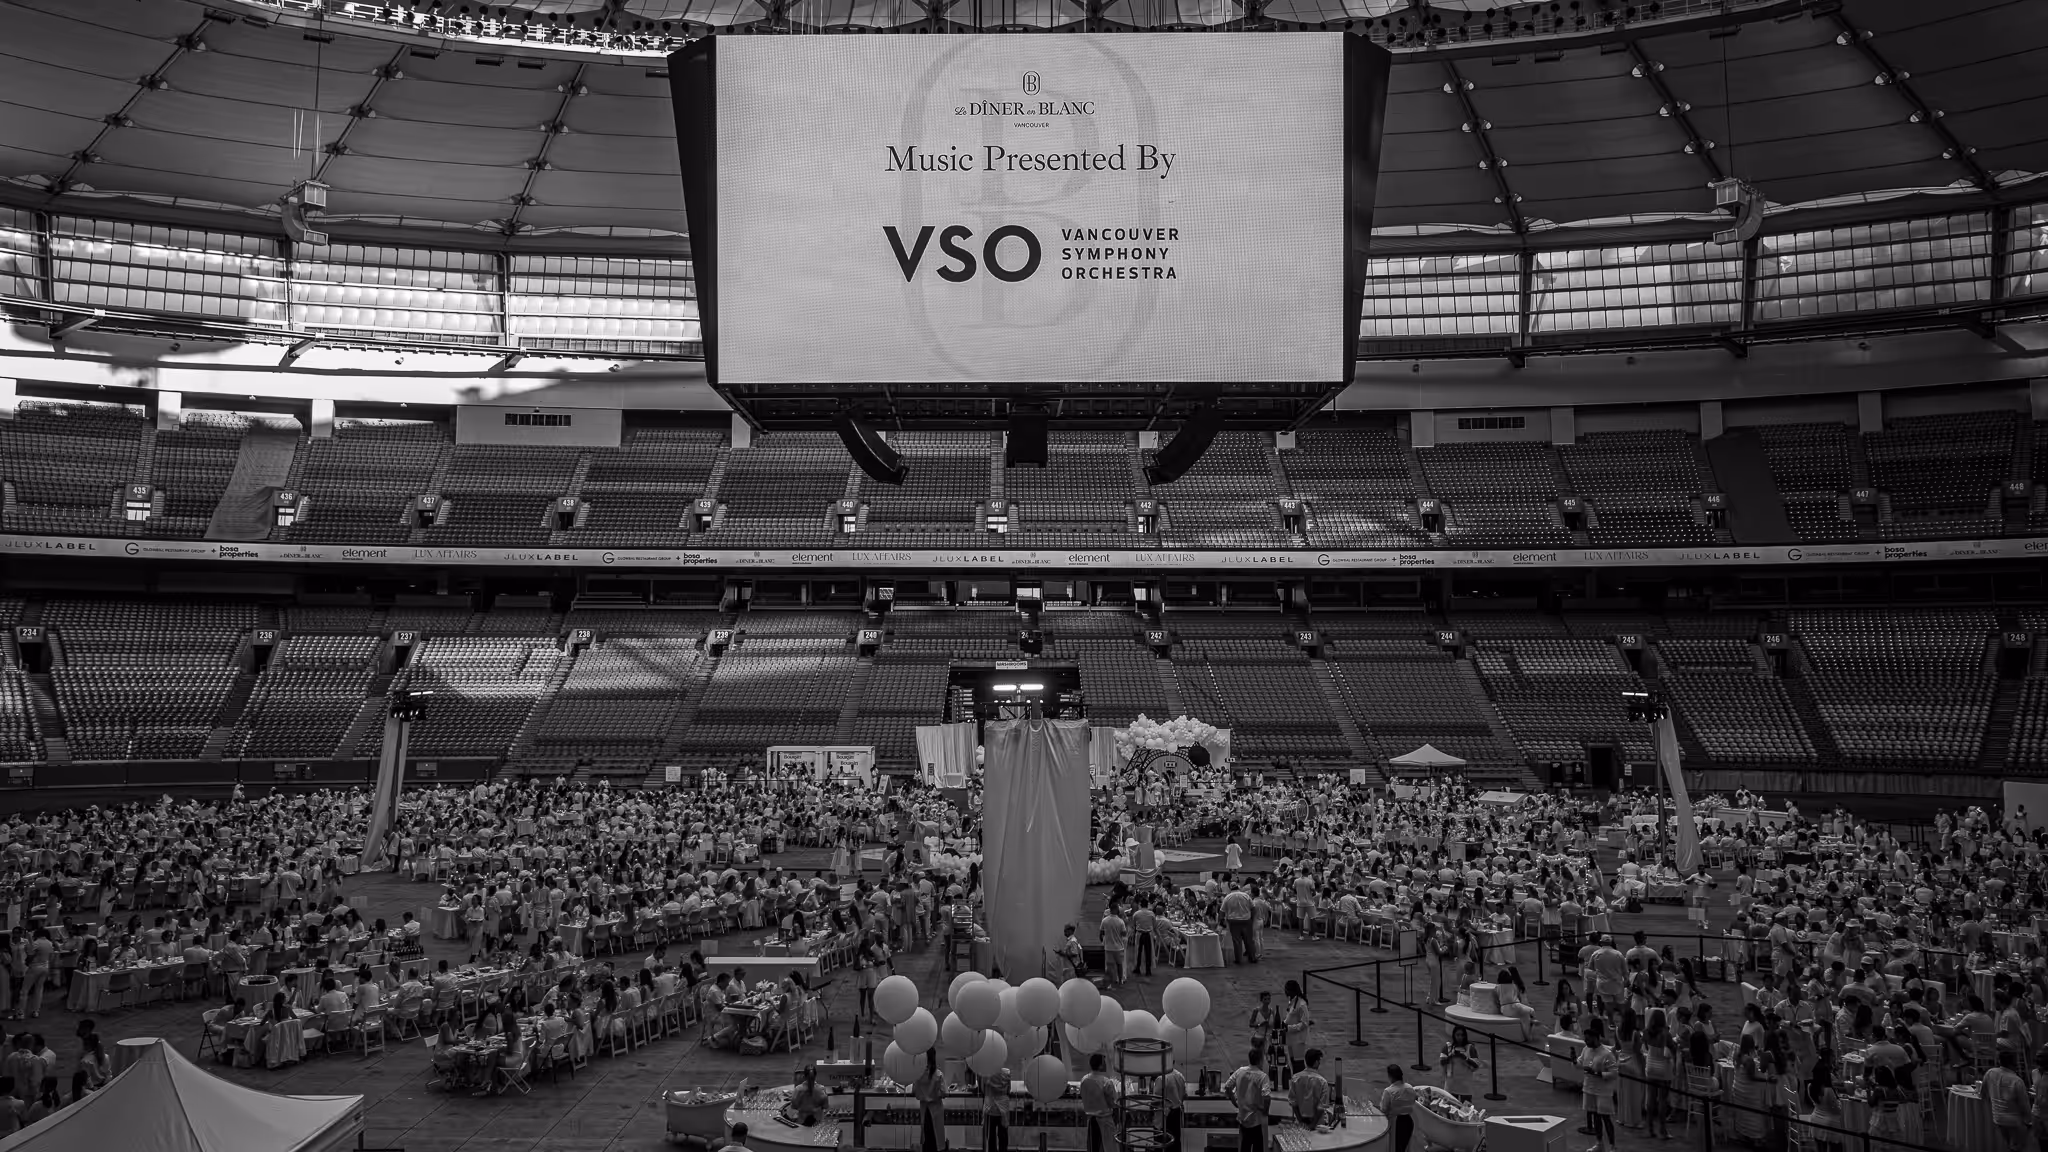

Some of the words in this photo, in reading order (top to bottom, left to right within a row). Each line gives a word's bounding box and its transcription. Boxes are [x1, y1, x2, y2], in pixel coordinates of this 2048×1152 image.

[969, 100, 1025, 116] DÎNER
[1039, 101, 1095, 116] BLANC
[884, 145, 974, 172] Music
[983, 144, 1127, 172] Presented
[1136, 144, 1177, 179] By
[1061, 228, 1180, 241] VANCOUVER
[882, 224, 1042, 283] VSO
[1062, 247, 1169, 260] SYMPHONY
[1061, 267, 1177, 280] ORCHESTRA
[1856, 490, 1869, 498] 447
[1708, 495, 1720, 503] 446
[342, 549, 387, 557] element
[414, 549, 433, 558] LUX
[792, 553, 833, 561] element
[872, 552, 912, 561] AFFAIRS
[1513, 553, 1556, 561] element
[1584, 552, 1602, 560] LUX
[1885, 550, 1927, 559] properties
[1068, 554, 1110, 562] element
[1135, 554, 1152, 562] LUX
[22, 628, 37, 636] 234
[400, 632, 413, 640] 237
[578, 630, 591, 638] 238
[1622, 636, 1635, 644] 245
[2010, 633, 2026, 642] 248
